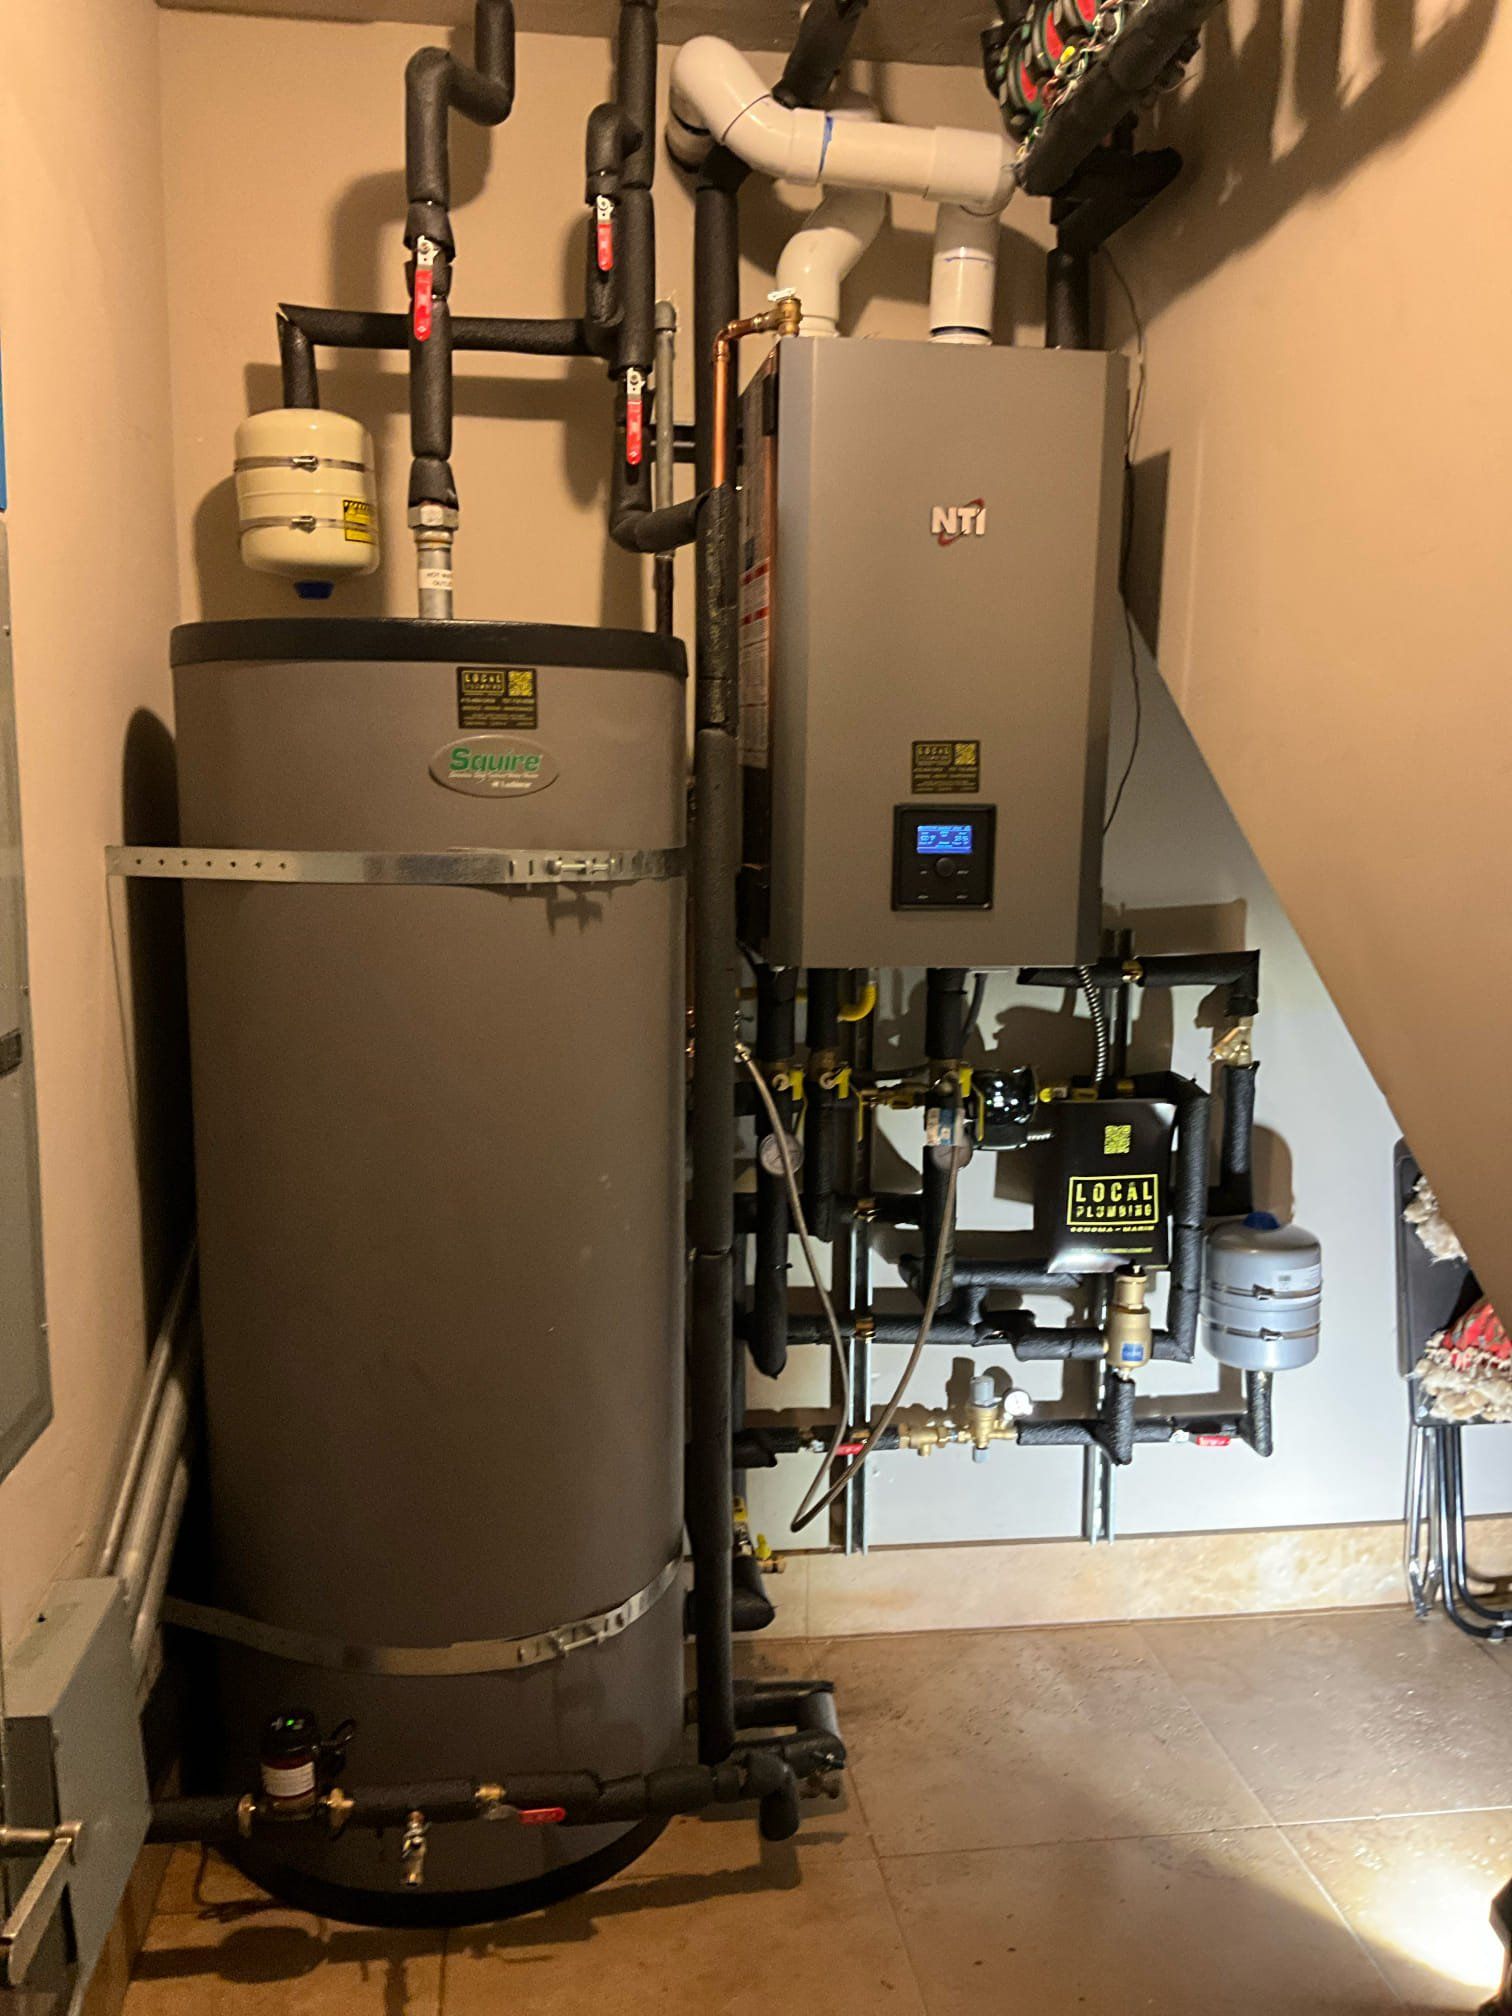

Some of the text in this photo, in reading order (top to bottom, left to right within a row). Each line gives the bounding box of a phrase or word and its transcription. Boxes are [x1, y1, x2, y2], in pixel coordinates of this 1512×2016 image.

[931, 506, 987, 535] NTI
[465, 673, 502, 683] LOCAL
[449, 747, 540, 773] Squire
[1075, 1181, 1153, 1203] LOCAL
[1076, 1203, 1153, 1218] PLUMBING
